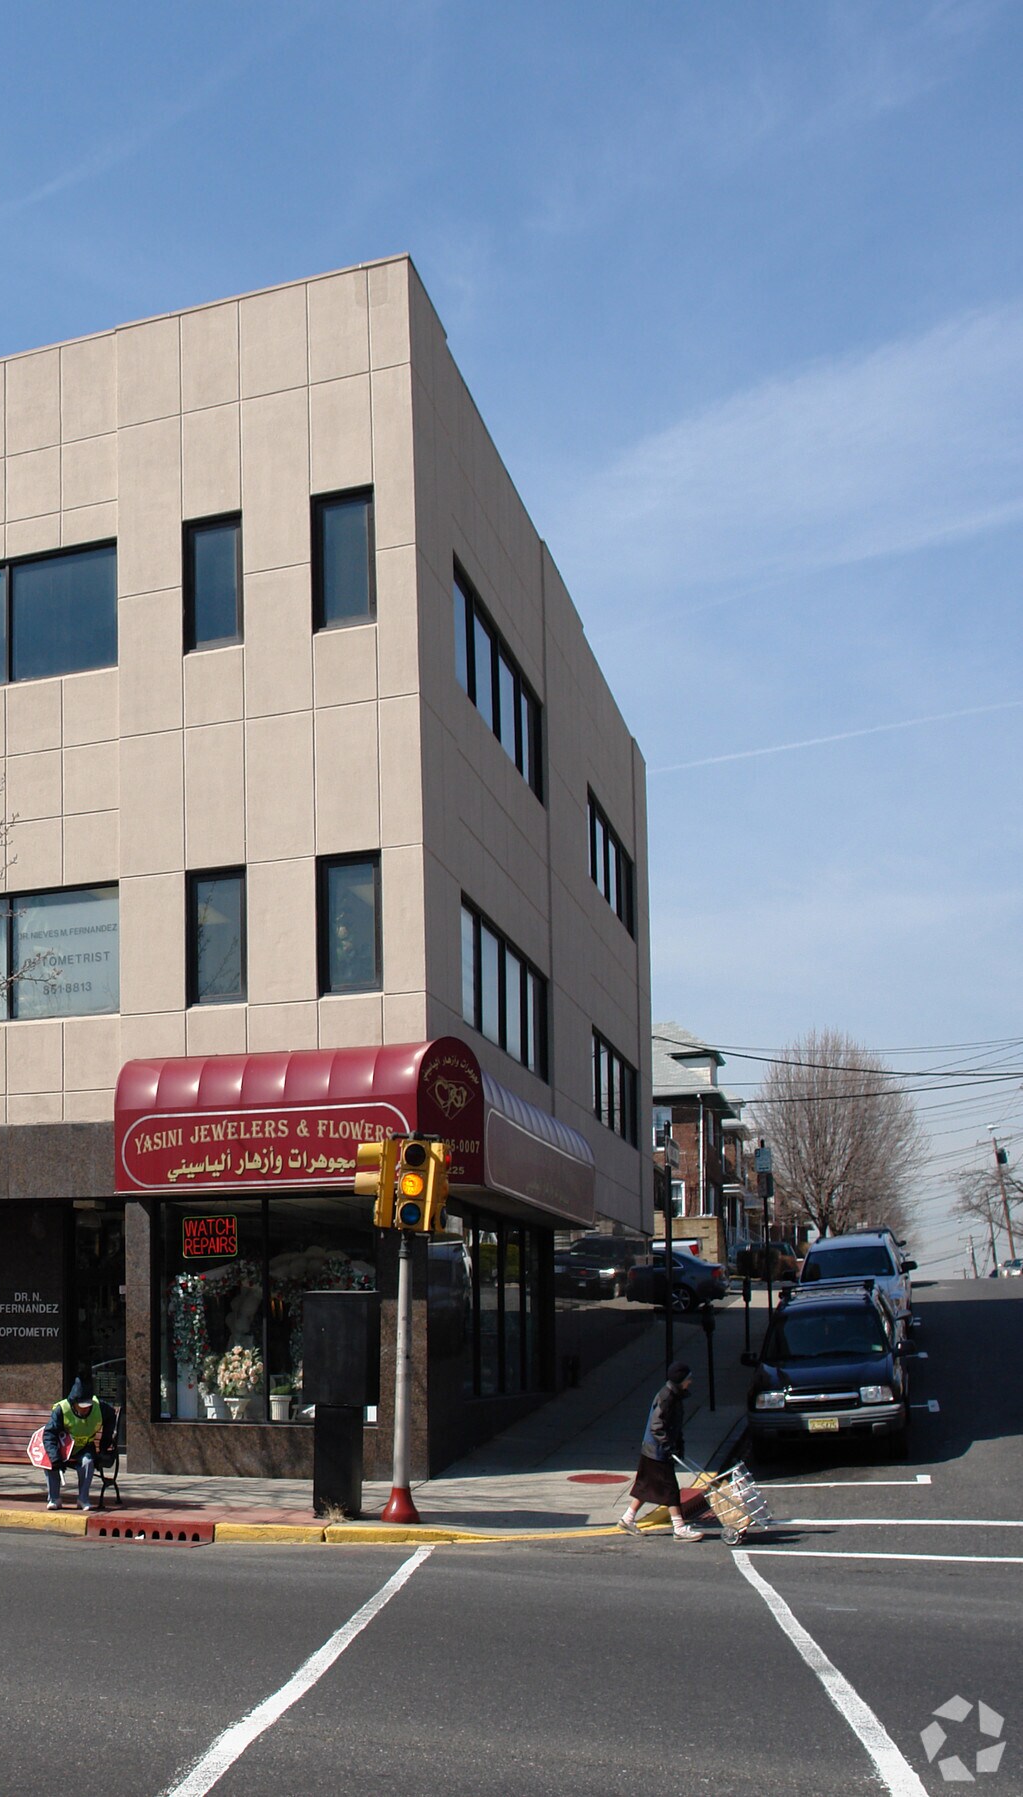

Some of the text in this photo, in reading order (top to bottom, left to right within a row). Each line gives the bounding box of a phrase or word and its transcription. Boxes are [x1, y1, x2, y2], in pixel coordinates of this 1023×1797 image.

[69, 923, 118, 936] FERNANDEZ
[135, 1119, 393, 1155] YASINI JEWELERS & FLOWERS
[235, 1146, 283, 1175] وأزهار
[288, 1149, 356, 1174] مجوهرات
[185, 1218, 235, 1237] WATCH
[184, 1236, 236, 1255] REPAIRS
[14, 1292, 42, 1302] DR. N.
[0, 1304, 59, 1314] FERNANDEZ
[0, 1327, 59, 1338] OPTOMETRY
